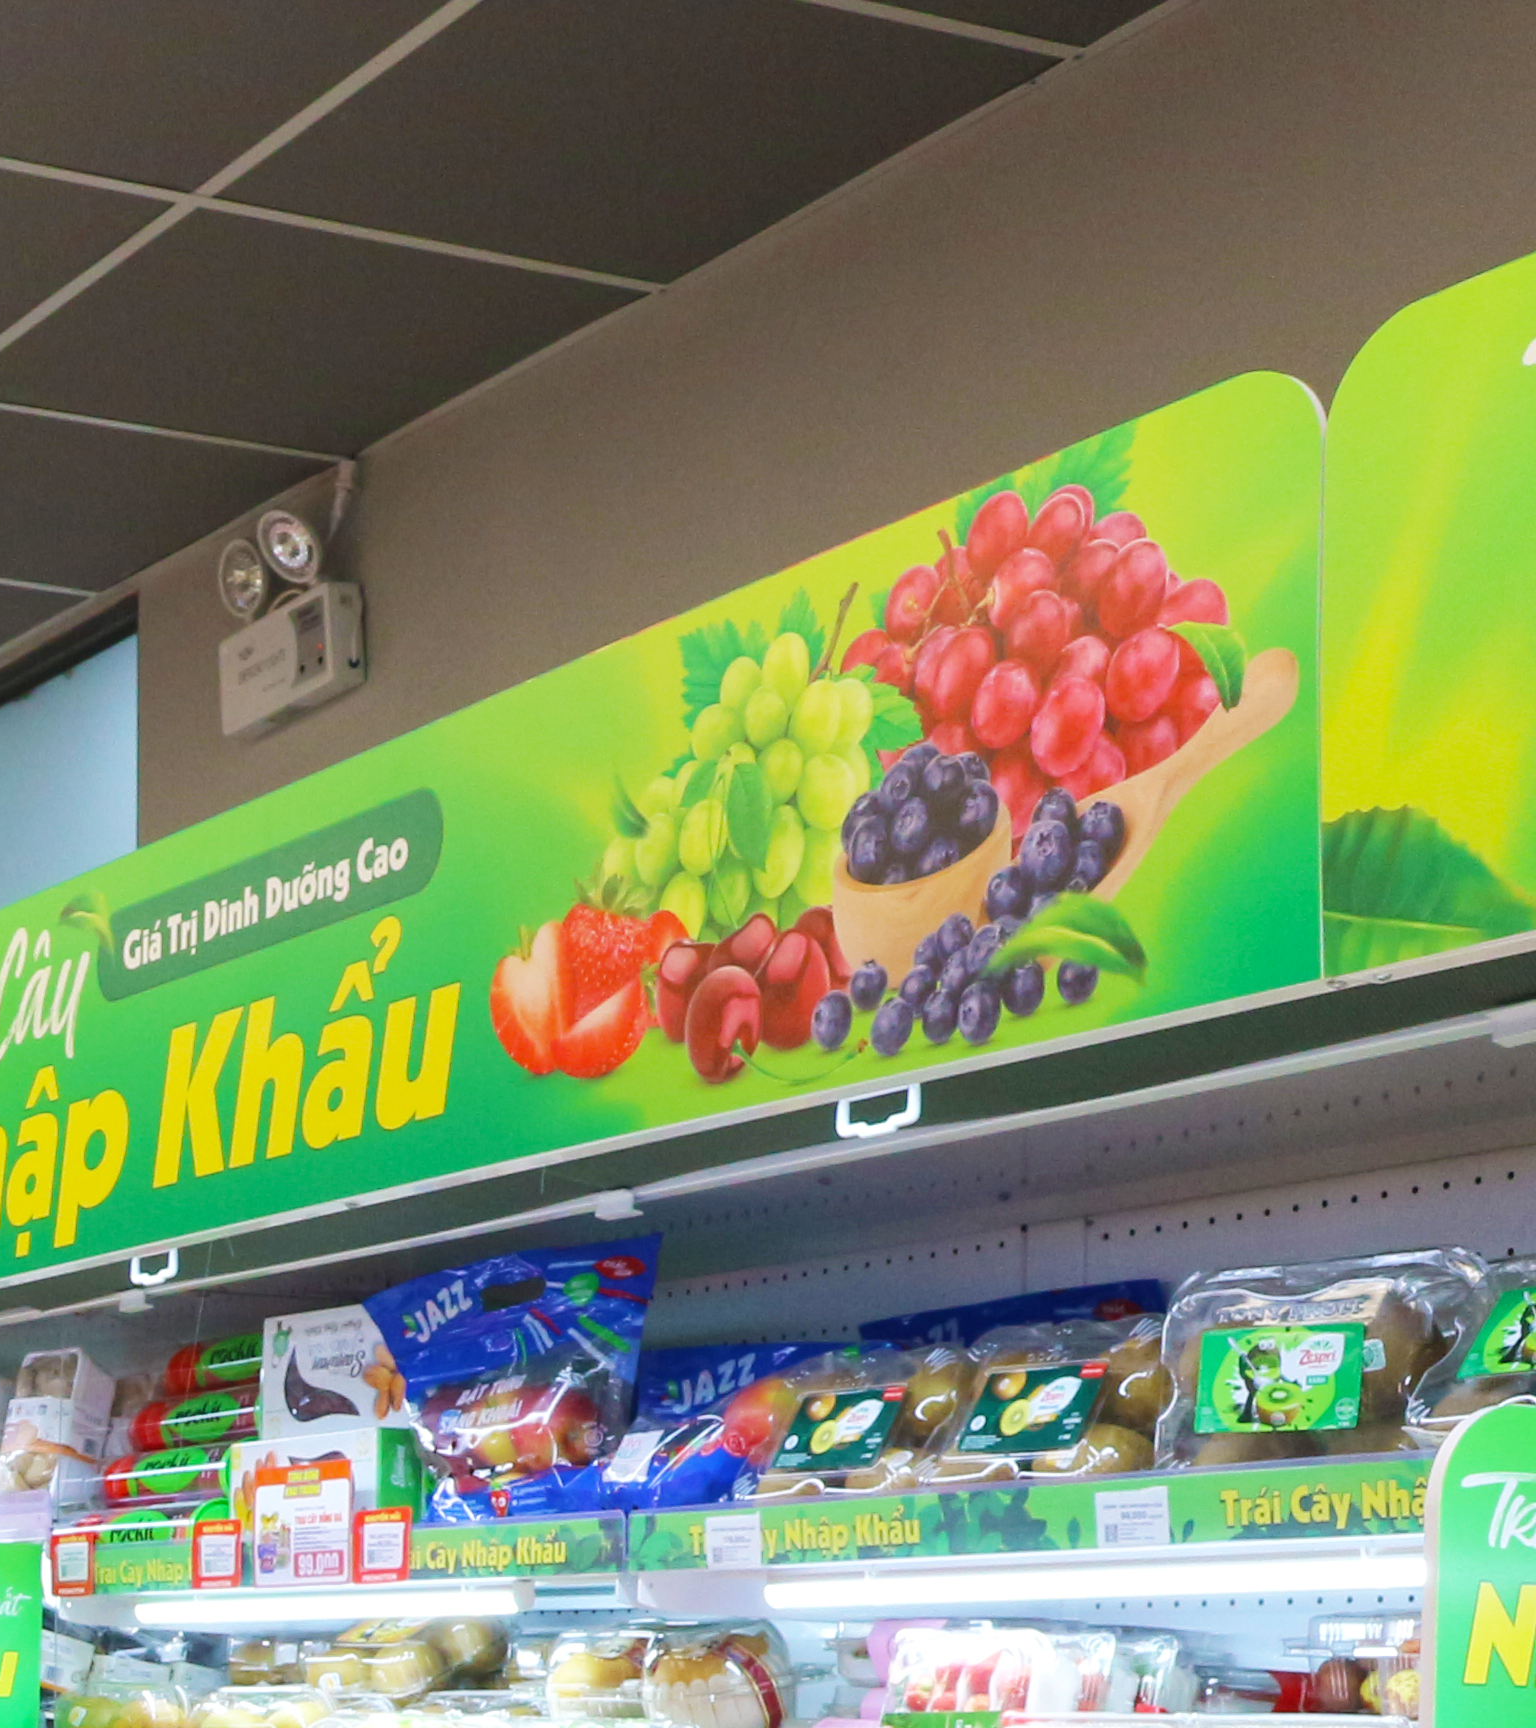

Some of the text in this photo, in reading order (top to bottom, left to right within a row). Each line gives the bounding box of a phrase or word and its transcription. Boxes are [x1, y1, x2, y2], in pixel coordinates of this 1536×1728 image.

[123, 836, 408, 970] Giá Trị Dinh Dưỡng Cao
[152, 915, 461, 1190] Khẩu
[413, 1280, 473, 1343] JAZZ
[672, 1353, 756, 1414] JAZZ
[1299, 1349, 1336, 1366] Zespri
[784, 1517, 849, 1556] Nhập
[855, 1505, 920, 1548] Khẩu
[1221, 1483, 1352, 1531] Trái Cây
[461, 1537, 512, 1572] Nhập
[517, 1528, 567, 1565] Khẩu
